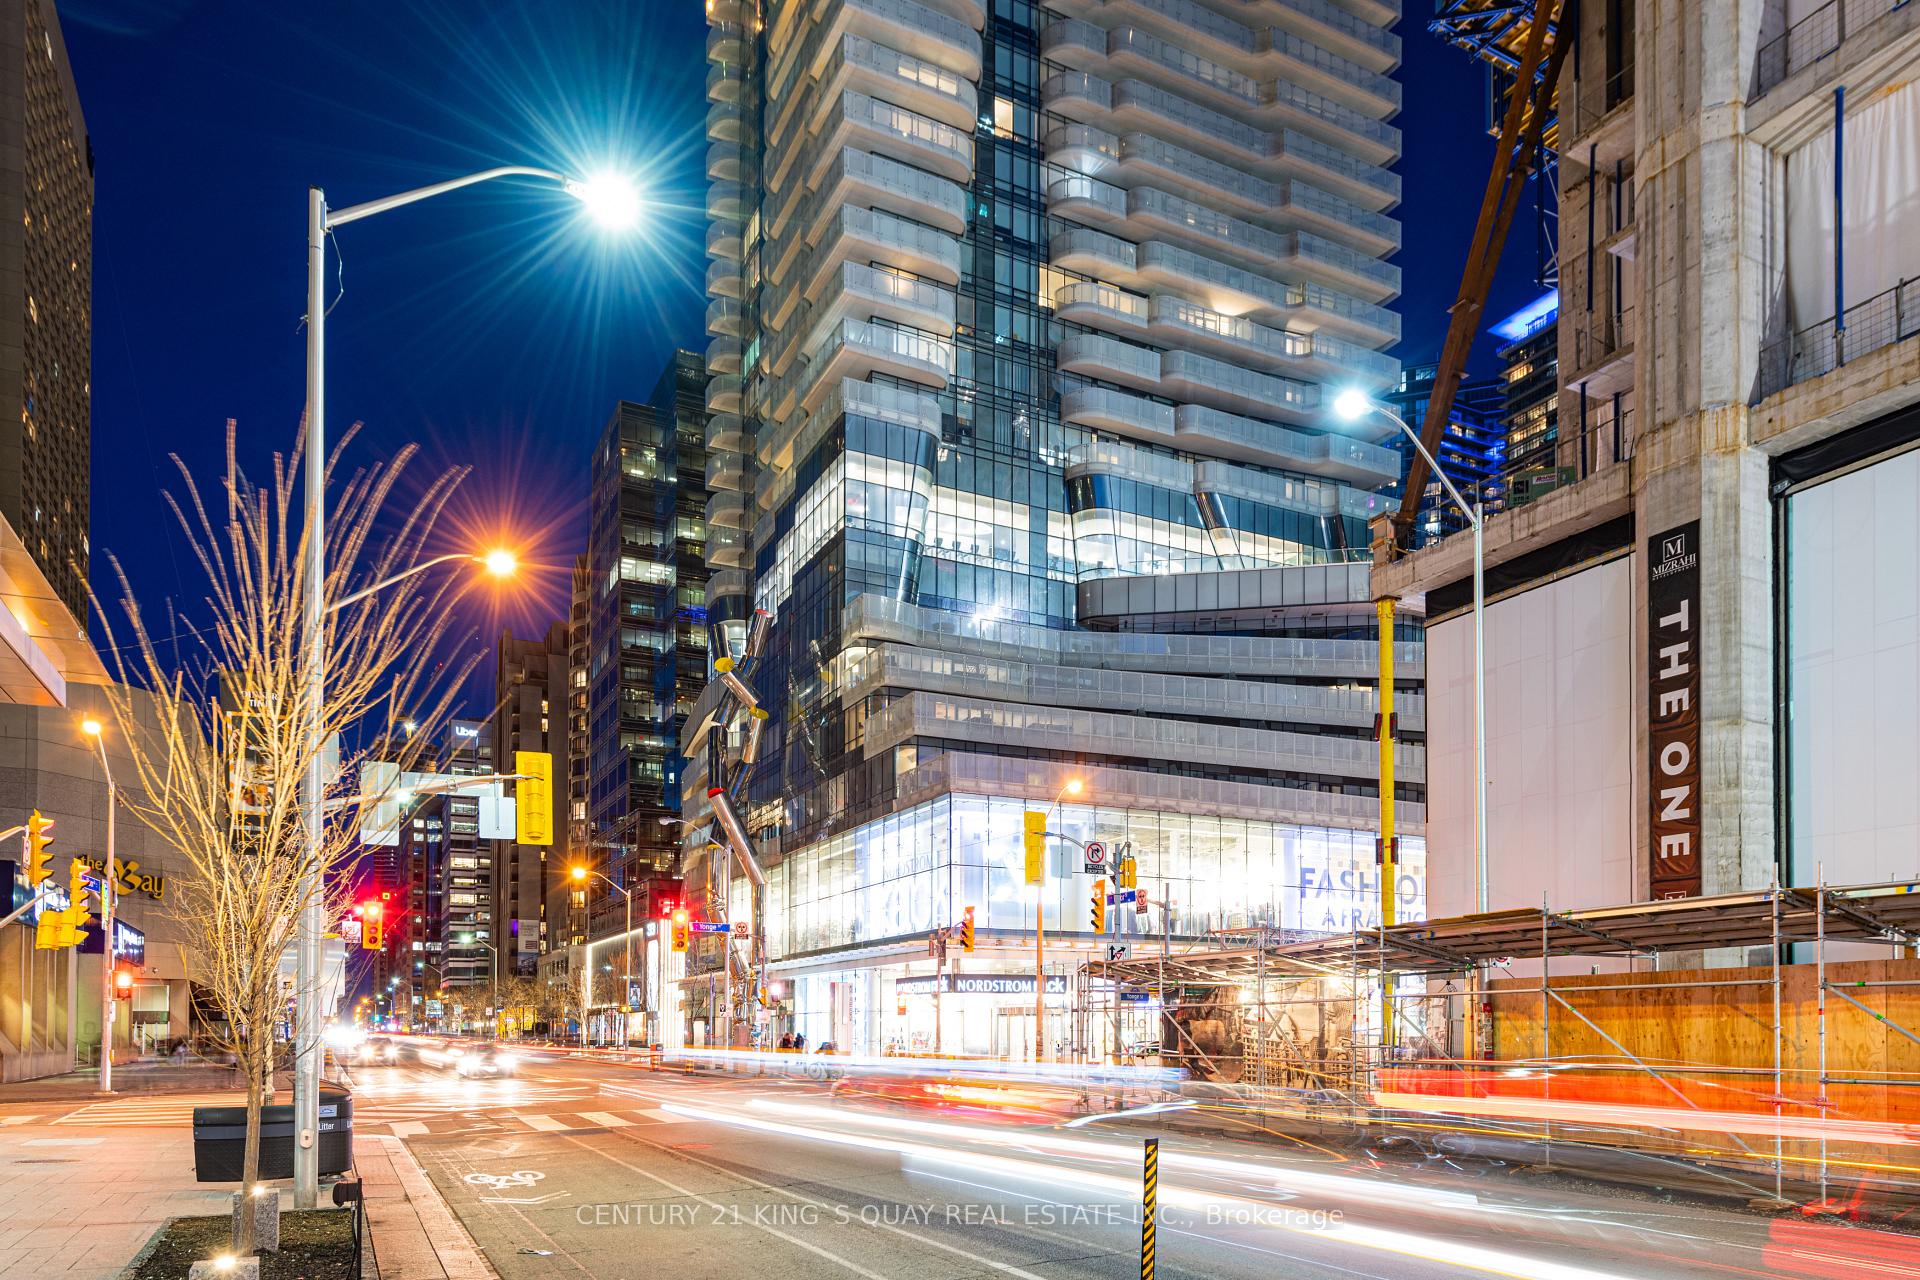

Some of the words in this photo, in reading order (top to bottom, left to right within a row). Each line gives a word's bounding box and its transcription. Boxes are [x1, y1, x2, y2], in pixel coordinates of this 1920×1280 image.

[1666, 539, 1682, 558] M
[1652, 553, 1696, 576] MIZRAHI
[1659, 600, 1689, 717] THE
[455, 726, 478, 736] Uber
[1659, 741, 1690, 859] ONE
[80, 854, 103, 870] the
[957, 979, 1031, 992] NORDSTROM
[319, 1122, 335, 1131] Litter
